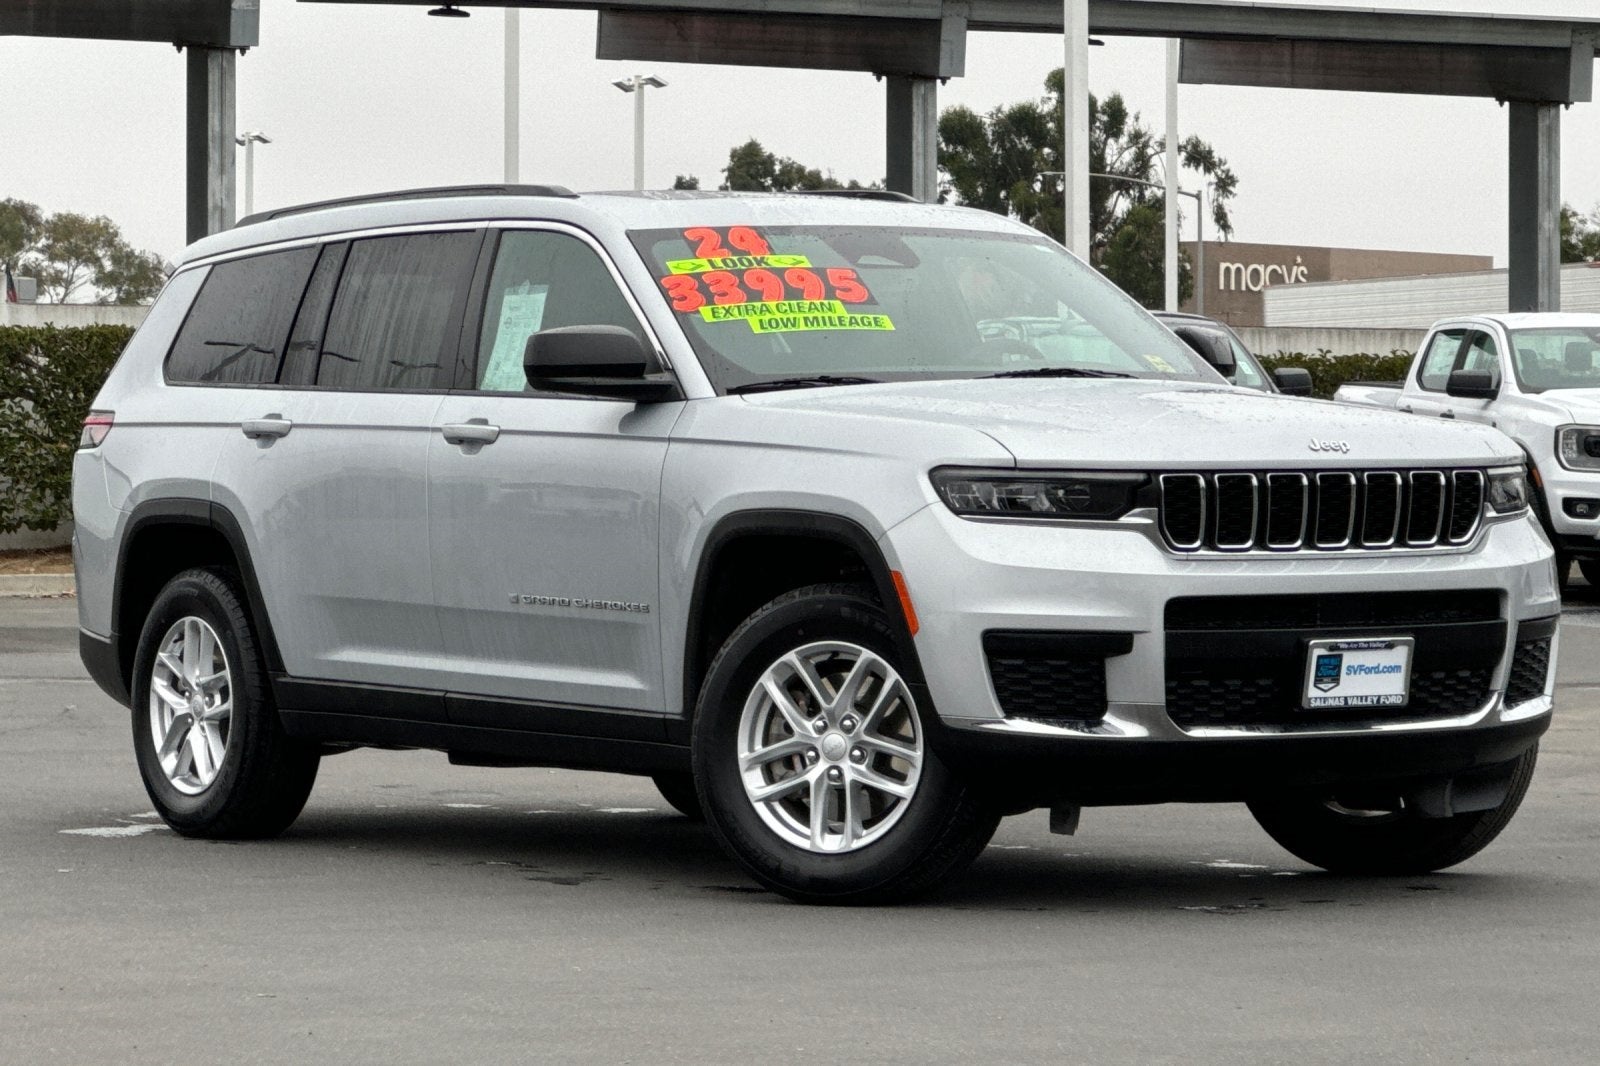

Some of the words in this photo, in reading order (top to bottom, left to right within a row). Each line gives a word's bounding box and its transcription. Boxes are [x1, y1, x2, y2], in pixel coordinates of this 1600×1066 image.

[707, 256, 772, 270] LOOK
[660, 268, 869, 312] 33995
[711, 304, 773, 319] EXTRA
[776, 301, 836, 314] CLEAN
[759, 316, 801, 330] LOW
[804, 315, 885, 329] MILEAGE
[1308, 438, 1350, 454] Jeep
[521, 594, 570, 607] GRAND
[573, 598, 650, 613] CHEROKEE
[1346, 663, 1402, 675] SVFord.com
[1347, 695, 1379, 706] VALLEY
[1380, 695, 1403, 704] FORD
